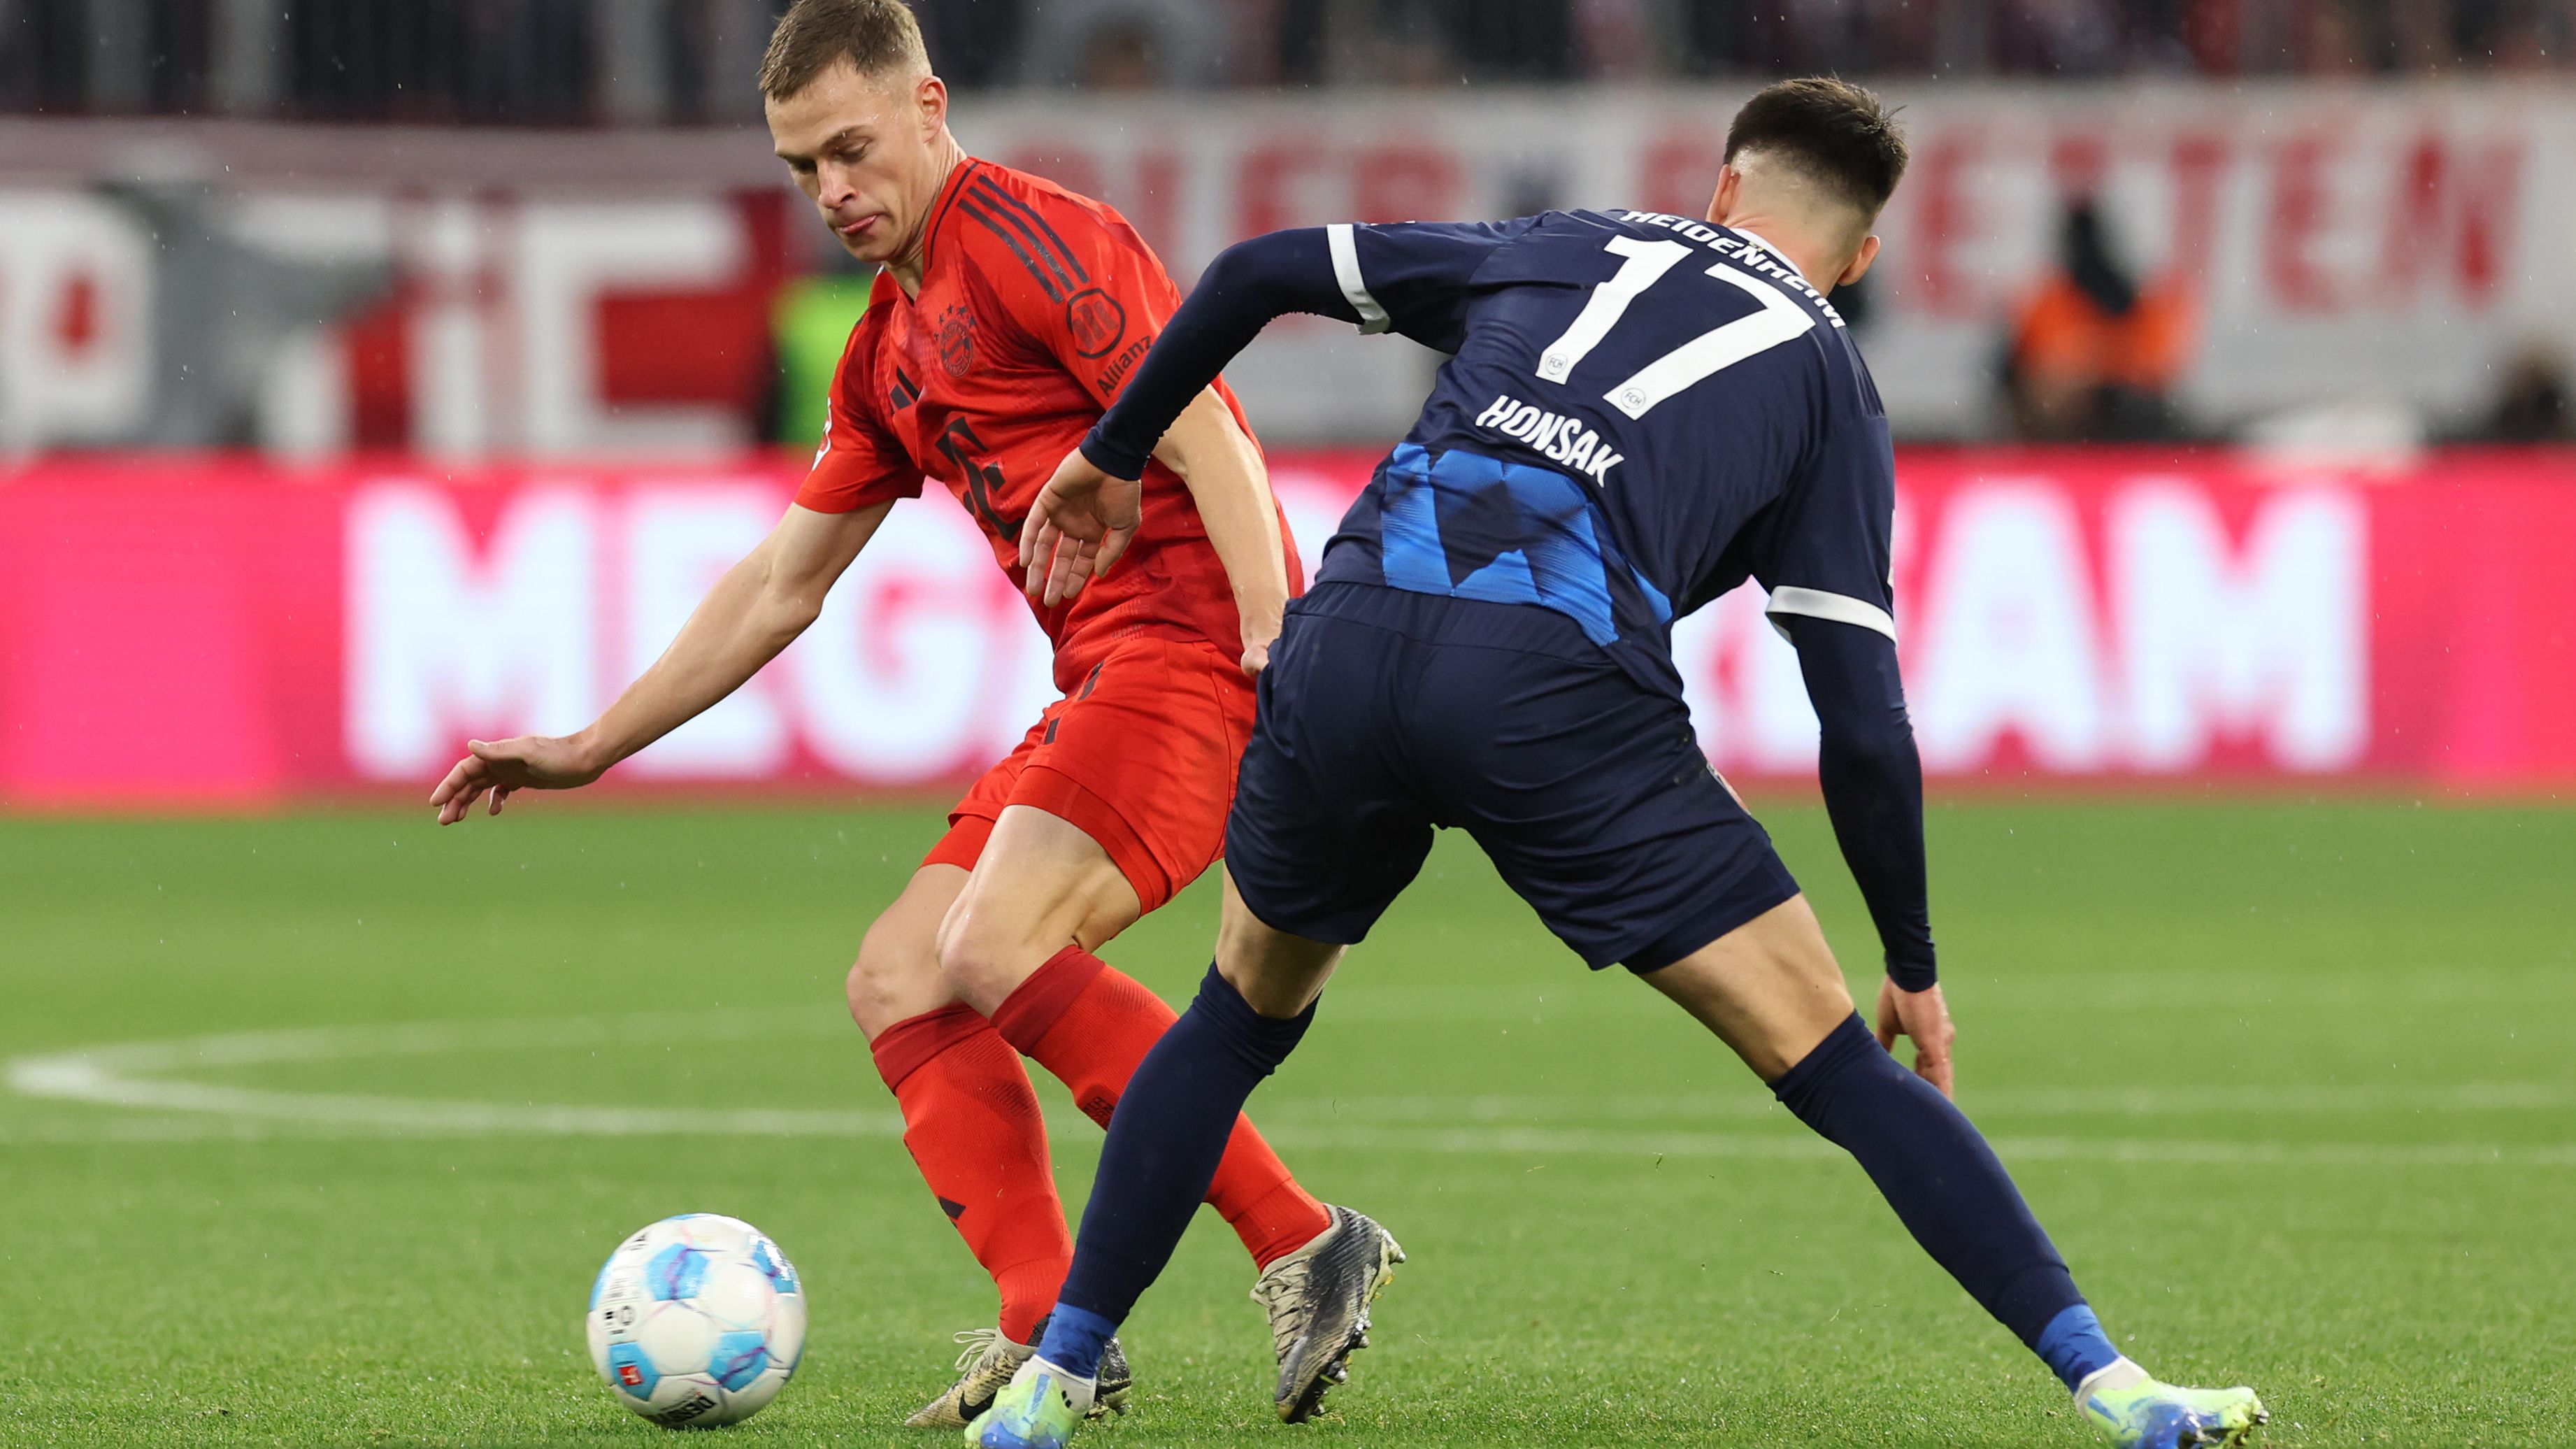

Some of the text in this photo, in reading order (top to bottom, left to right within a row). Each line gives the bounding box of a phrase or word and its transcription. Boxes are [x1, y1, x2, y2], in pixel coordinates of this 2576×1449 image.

[1620, 210, 1846, 328] HEIDENHEIM
[1531, 234, 1816, 420] 17
[1547, 357, 1564, 369] FCH
[1096, 336, 1151, 398] Allianz
[1624, 392, 1643, 405] FCH
[1475, 395, 1625, 488] HONSAK
